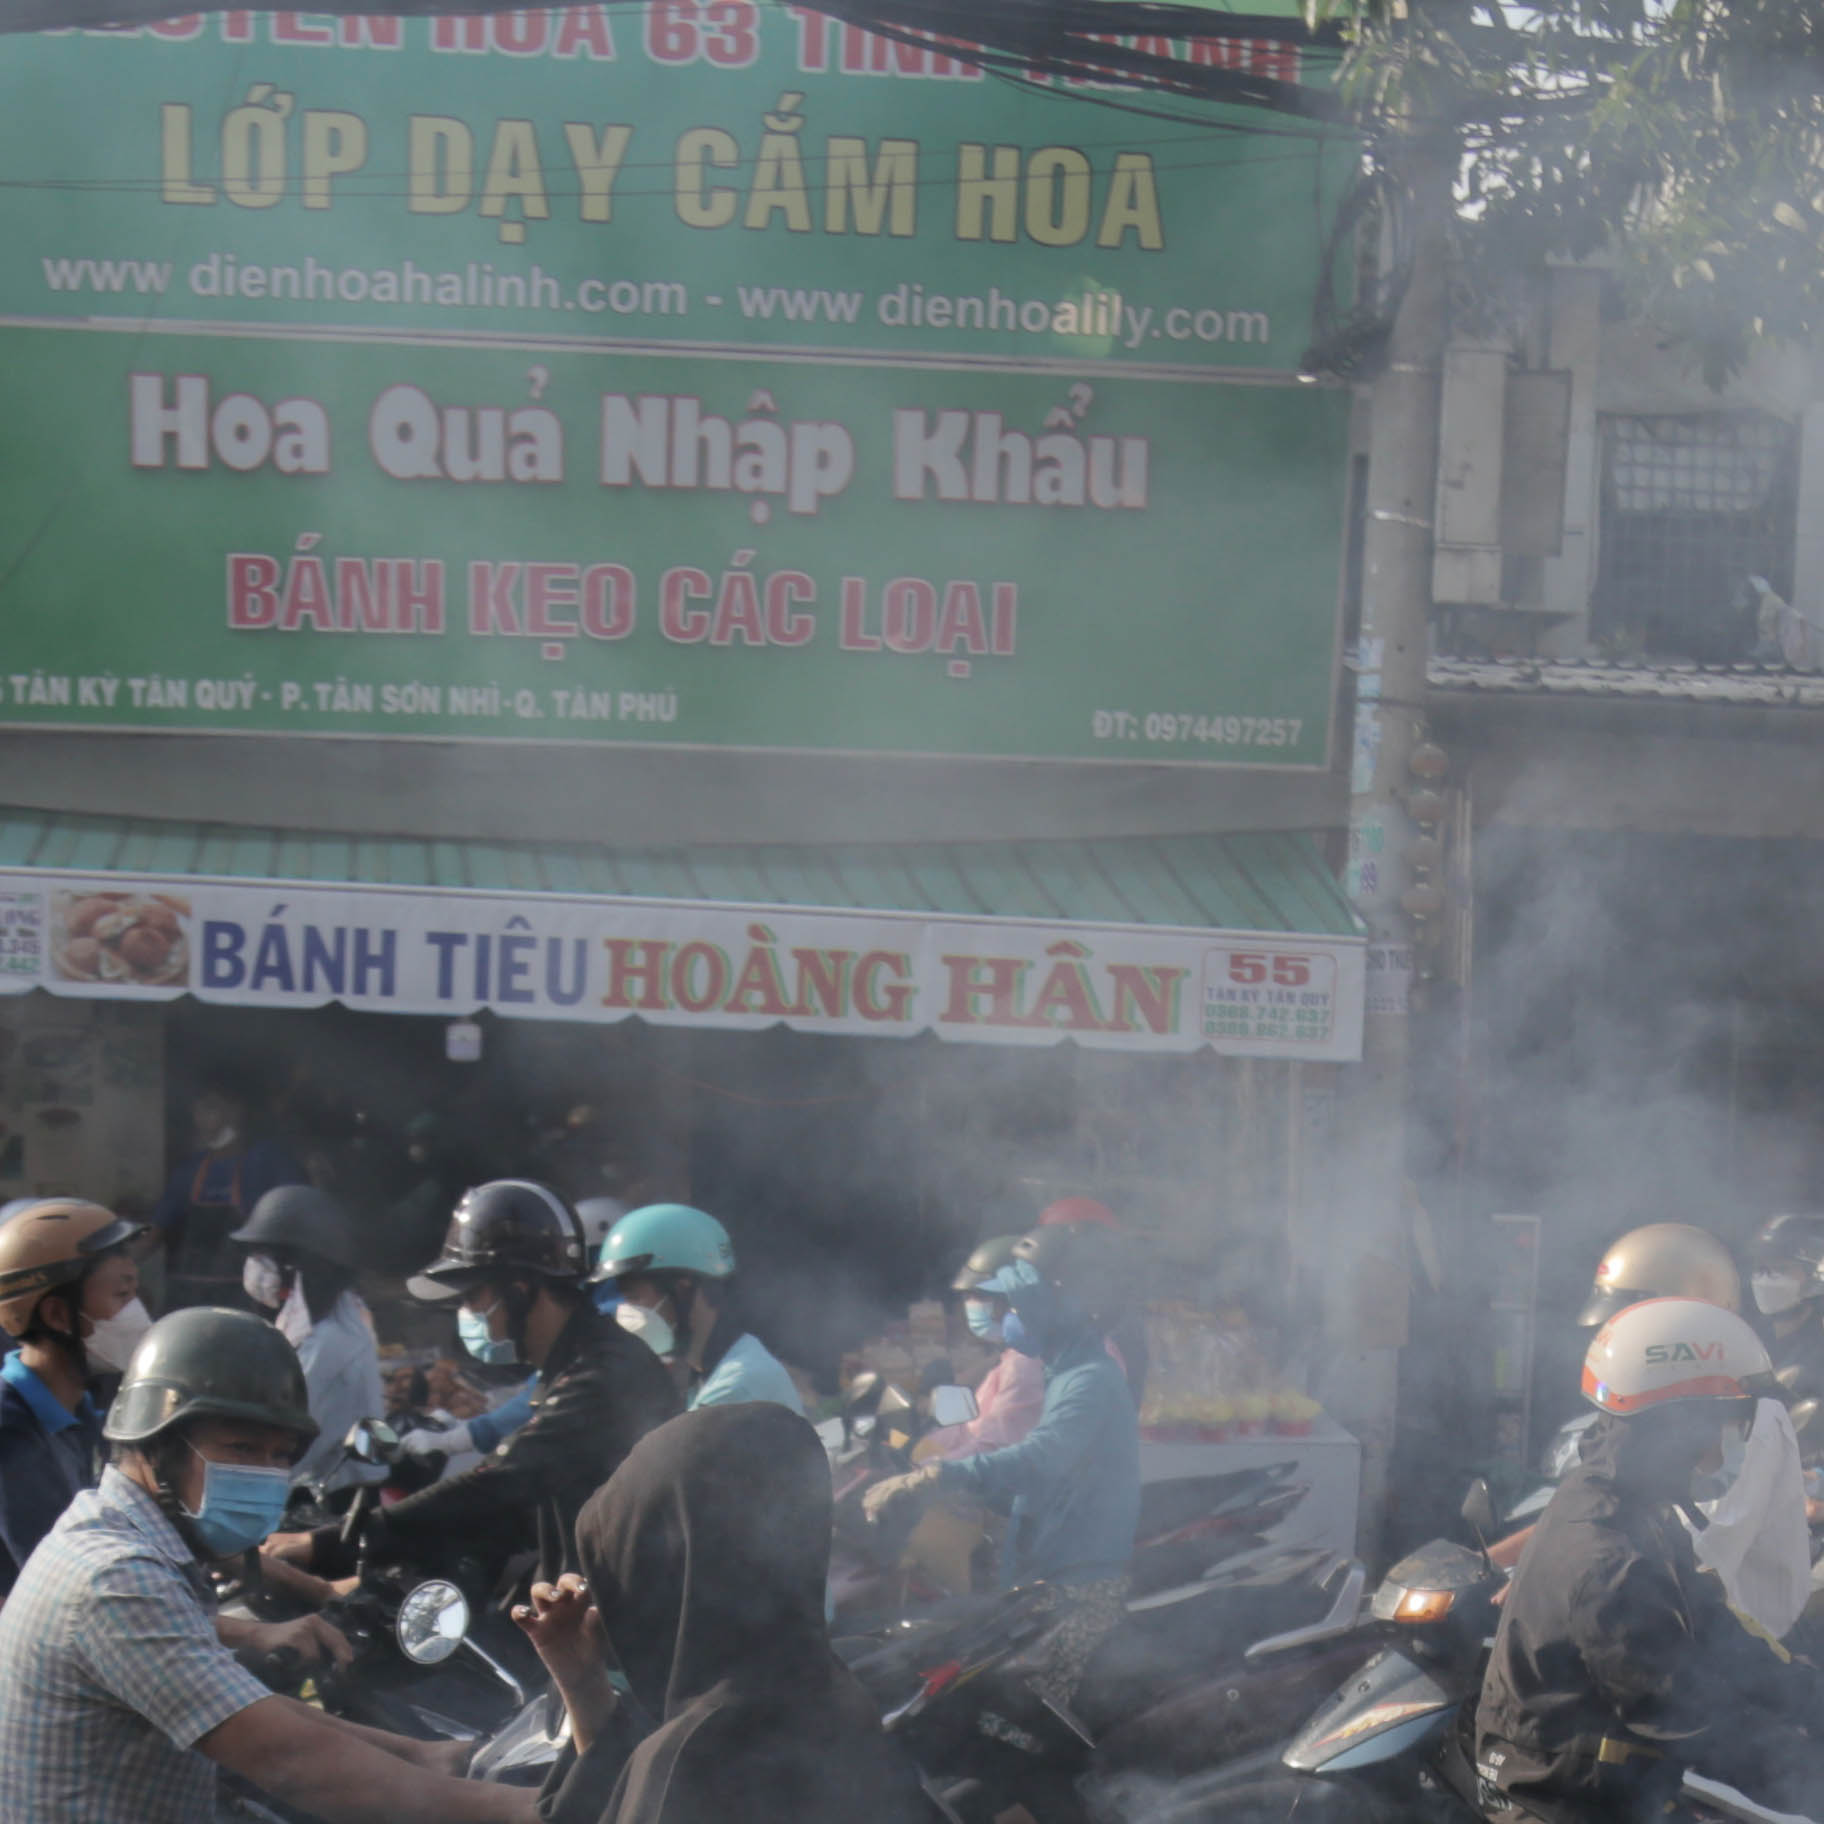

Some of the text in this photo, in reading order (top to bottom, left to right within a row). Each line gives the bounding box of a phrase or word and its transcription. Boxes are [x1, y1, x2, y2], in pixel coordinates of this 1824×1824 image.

[644, 0, 760, 68] 63
[160, 83, 1164, 250] LỚP DẠY CẮM HOA
[190, 254, 687, 315] dienhoahalinh.com
[879, 283, 1270, 348] dienhoalily.com
[128, 365, 1148, 526] Hoa Quả Nhập Khẩu
[226, 532, 1019, 679] BÁNH KẸO CÁC LOẠI
[201, 904, 1191, 1033] BÁNH TIÊU HOÀNG HÂN
[1229, 953, 1311, 986] 55
[1646, 1342, 1724, 1364] SAVI
